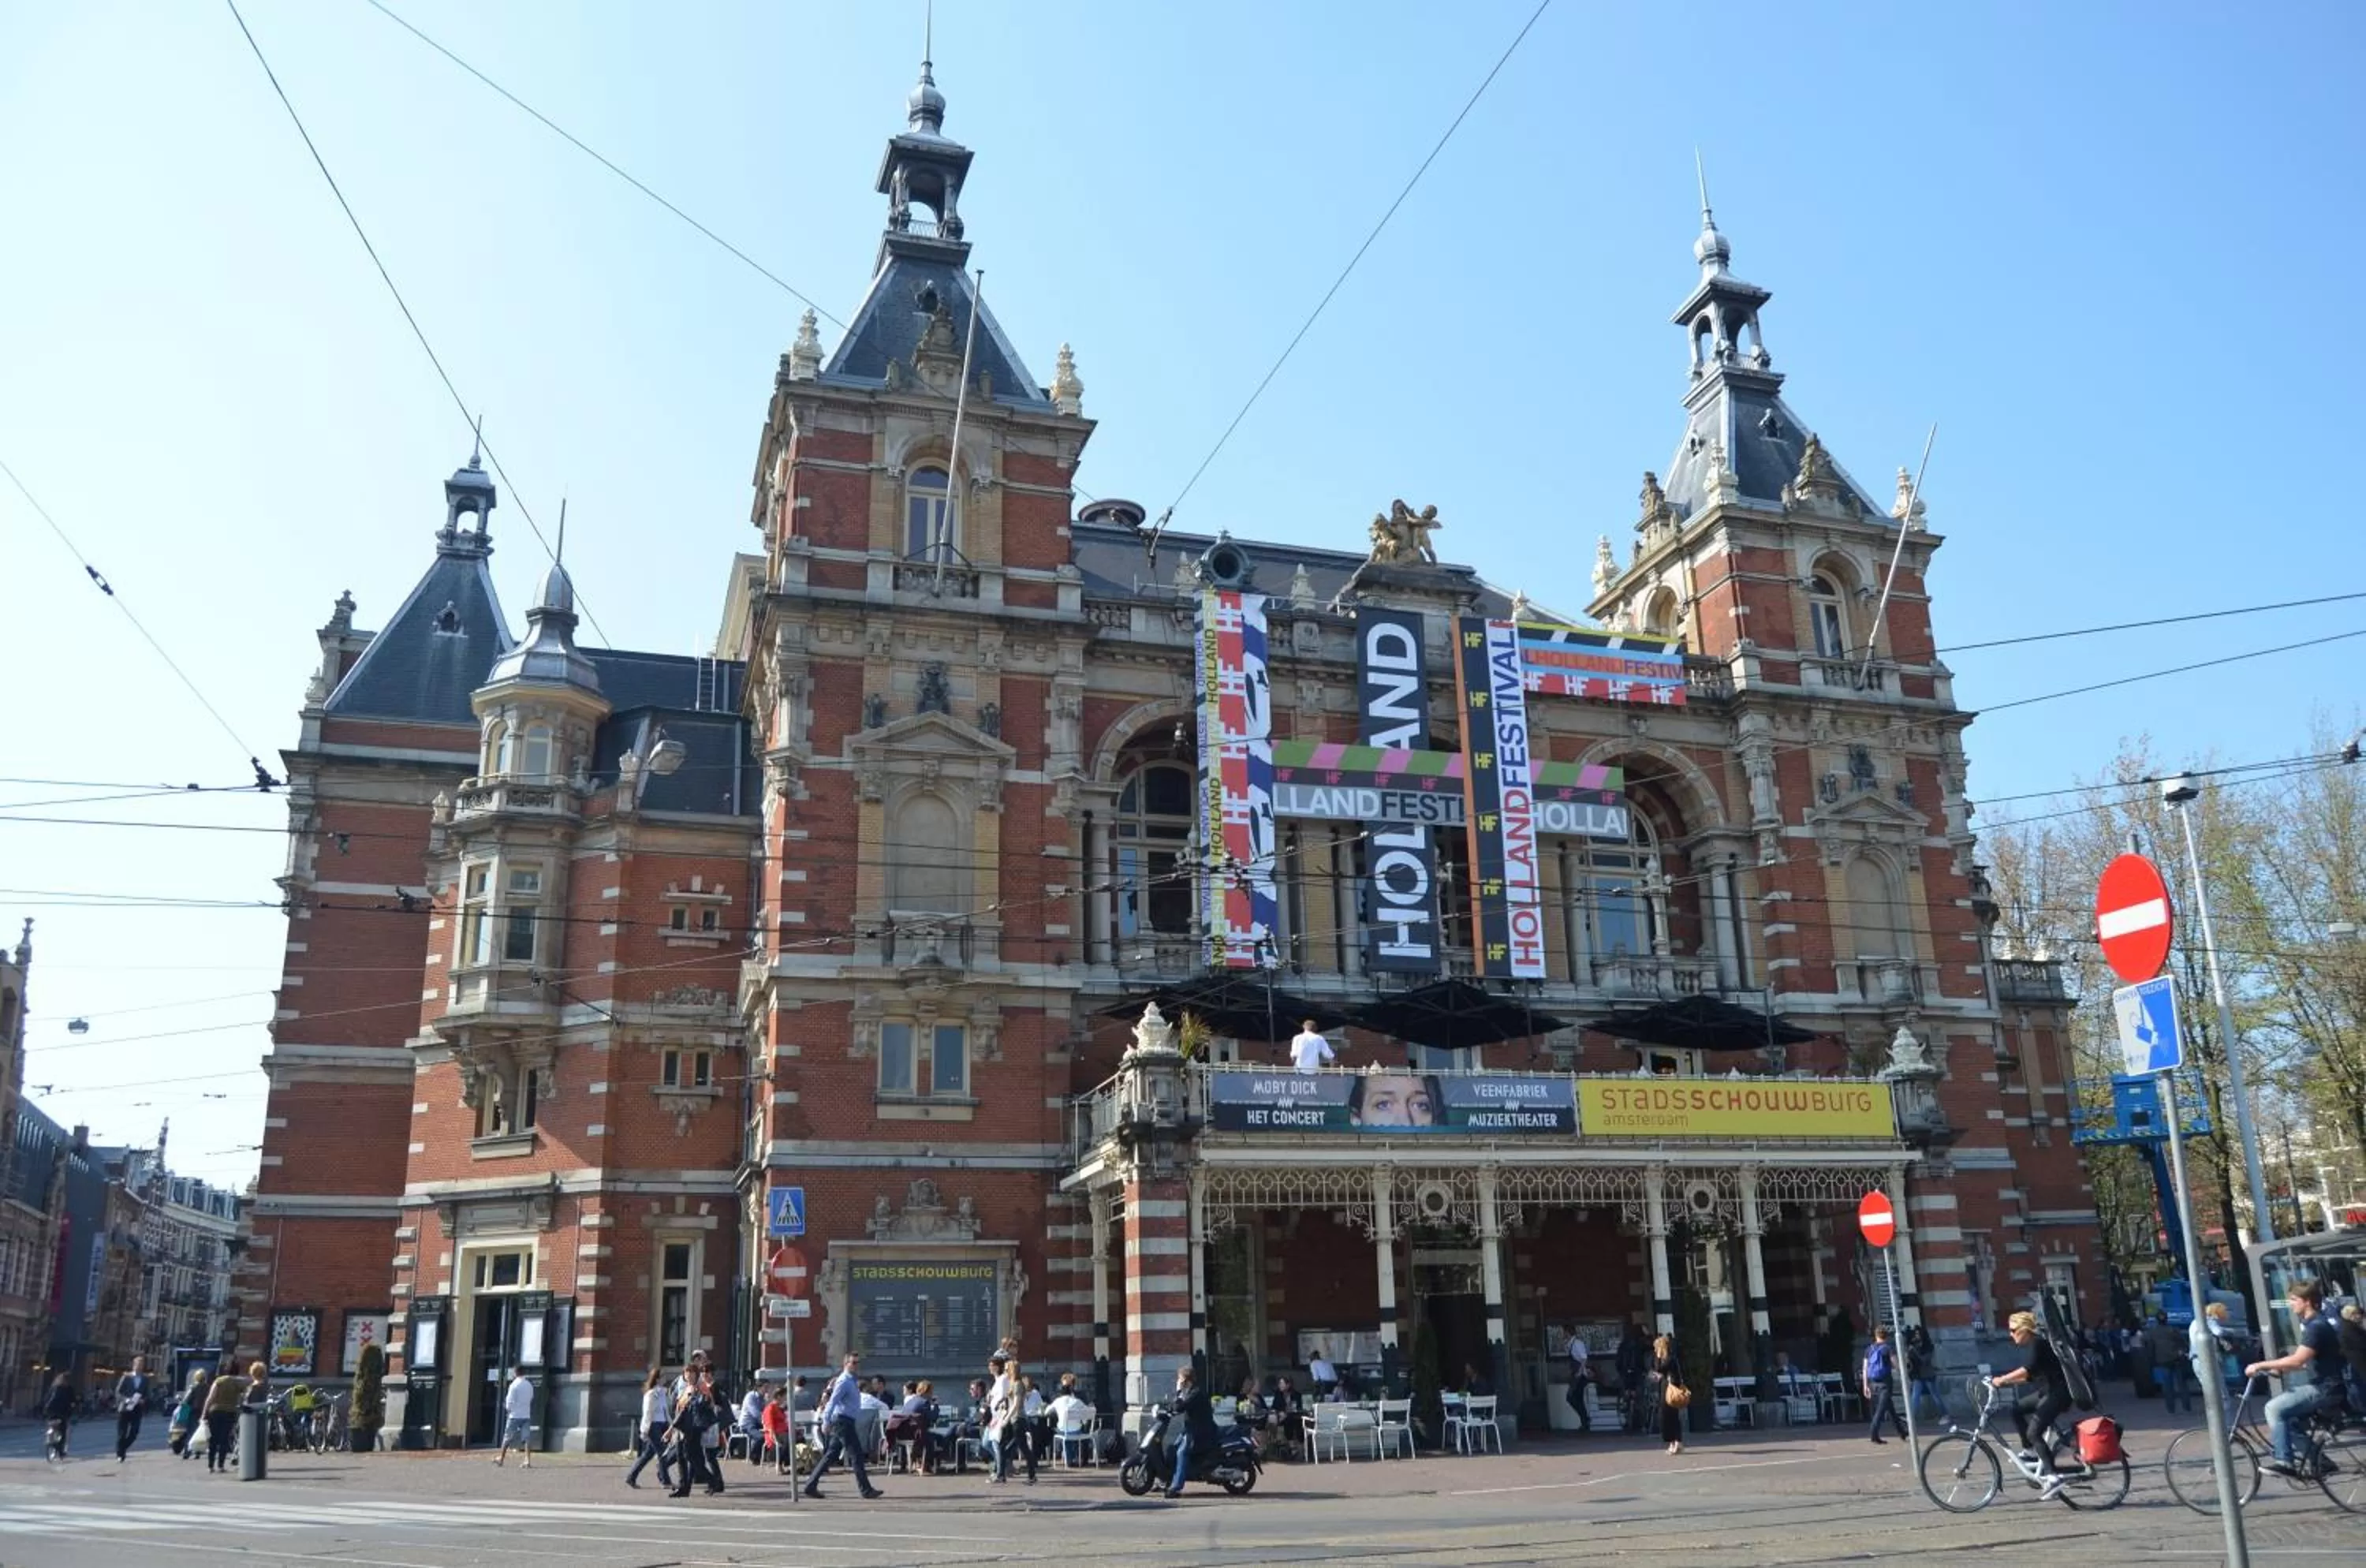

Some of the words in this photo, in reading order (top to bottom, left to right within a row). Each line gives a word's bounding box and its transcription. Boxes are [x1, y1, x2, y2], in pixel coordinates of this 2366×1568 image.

[1462, 631, 1483, 648] HF
[1205, 629, 1218, 703] HOLLAND
[1564, 674, 1590, 697] HF
[1608, 679, 1634, 701] HF
[1651, 683, 1677, 704] HF
[1469, 691, 1489, 707] HF
[1474, 752, 1494, 768] HF
[1277, 769, 1294, 781] HF
[1326, 770, 1343, 785] HF
[1375, 775, 1392, 788] HF
[1422, 778, 1439, 791] HF
[1602, 791, 1616, 805] HF
[1209, 777, 1224, 857] HOLLAND
[1479, 815, 1498, 831] HF
[1487, 943, 1507, 960] HF
[1253, 1080, 1286, 1095] MOBY
[1291, 1081, 1317, 1095] DICK
[1472, 1085, 1547, 1098] VEENFABRIEK
[1247, 1110, 1268, 1124] HET
[1272, 1111, 1325, 1126] CONCERT
[1468, 1113, 1558, 1127] MUZIEKTHEATER
